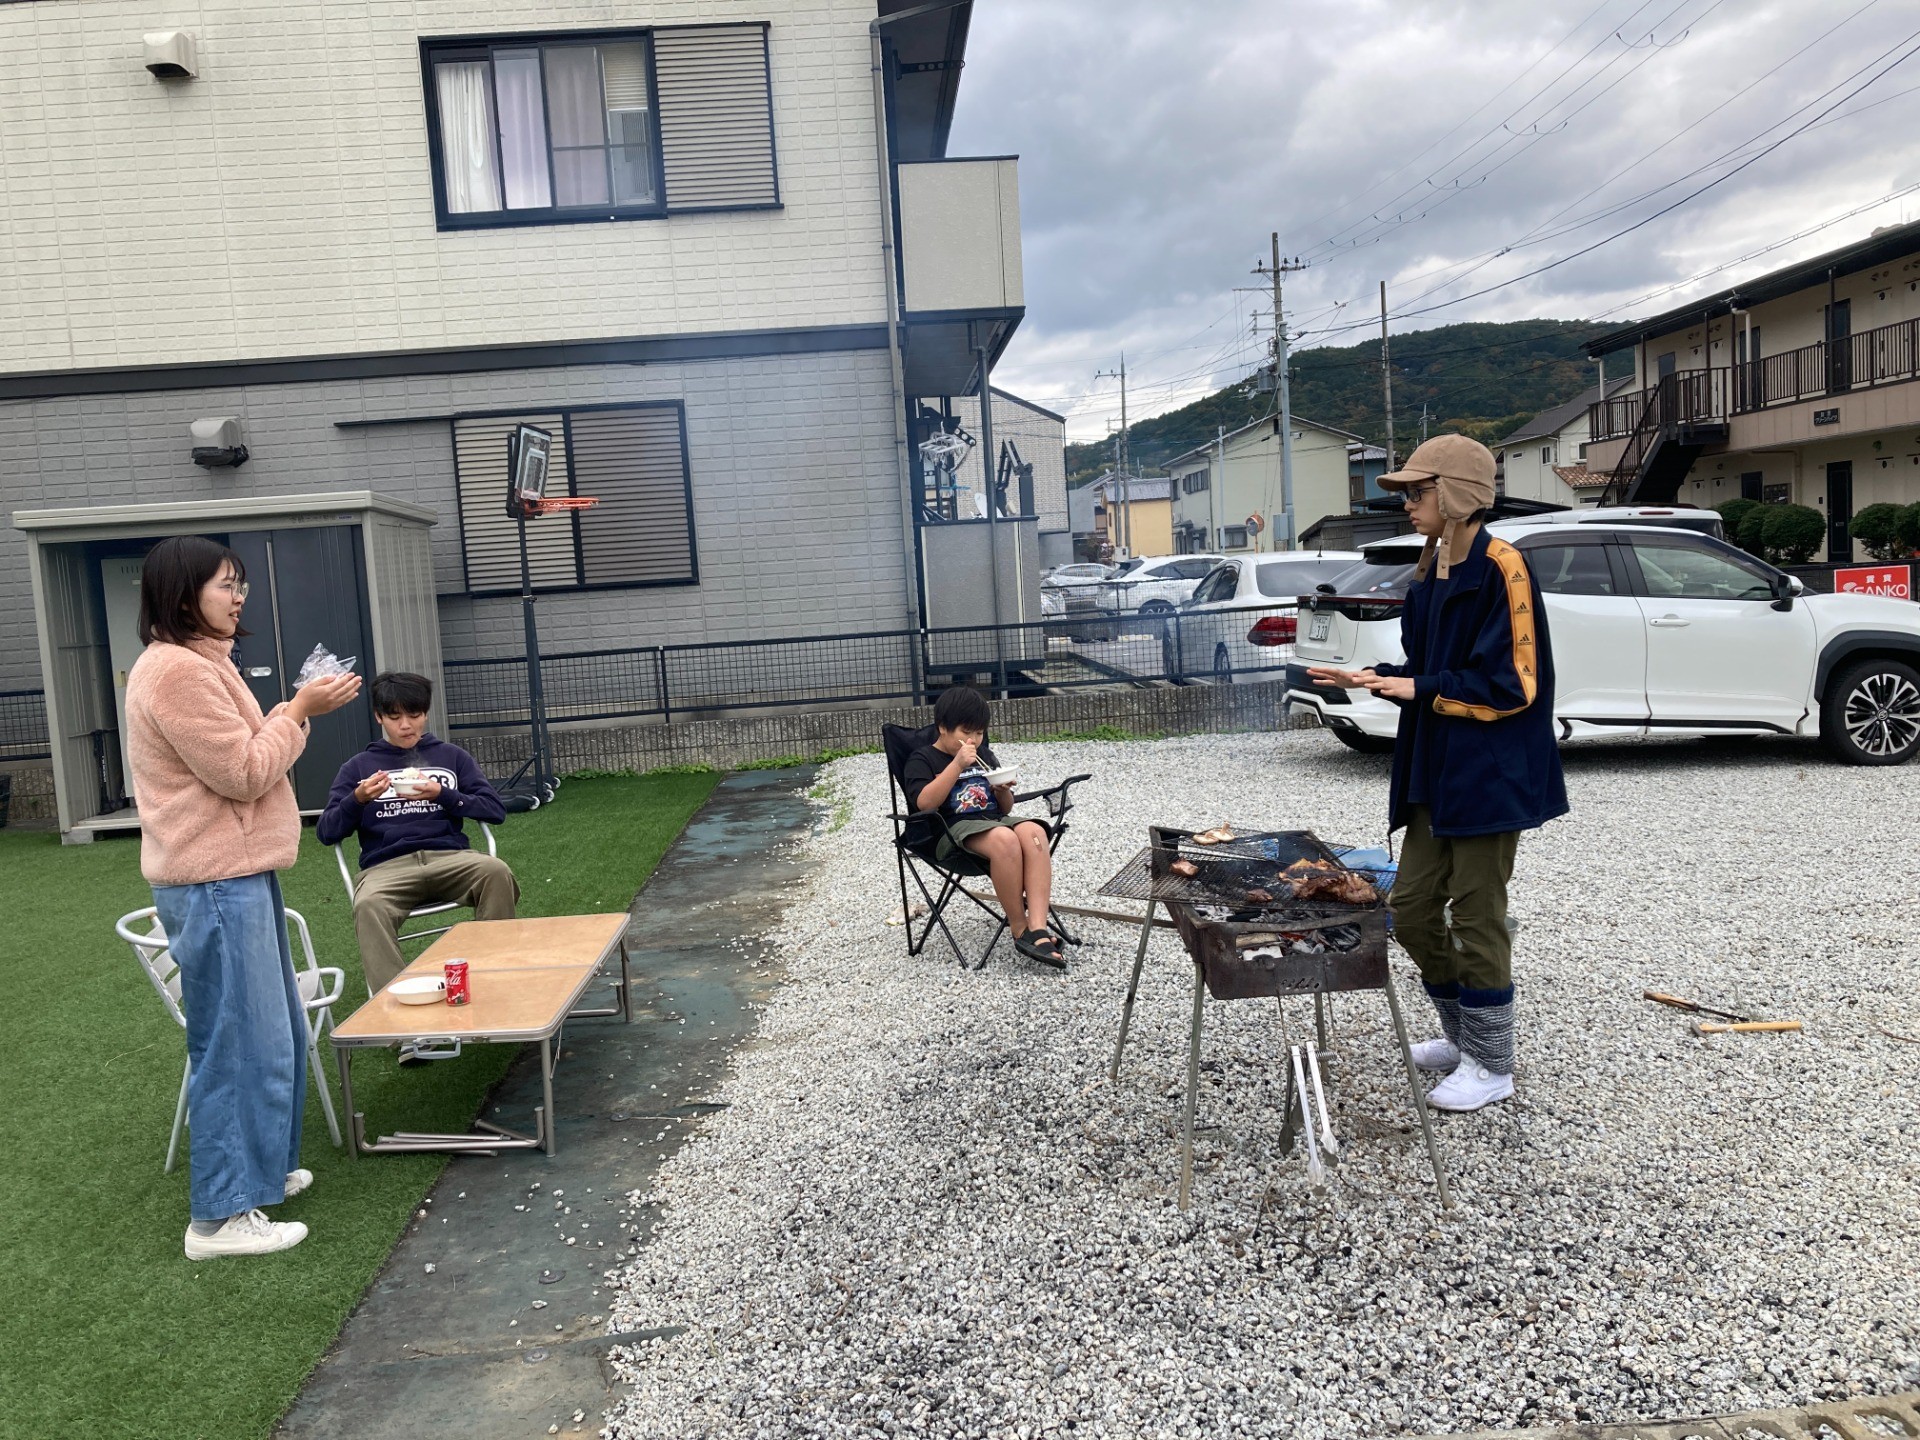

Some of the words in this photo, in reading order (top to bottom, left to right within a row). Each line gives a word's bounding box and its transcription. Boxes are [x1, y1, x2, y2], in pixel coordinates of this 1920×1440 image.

[384, 802, 401, 810] LOS
[403, 800, 437, 808] ANGEL
[376, 806, 428, 818] CALIFORNIA
